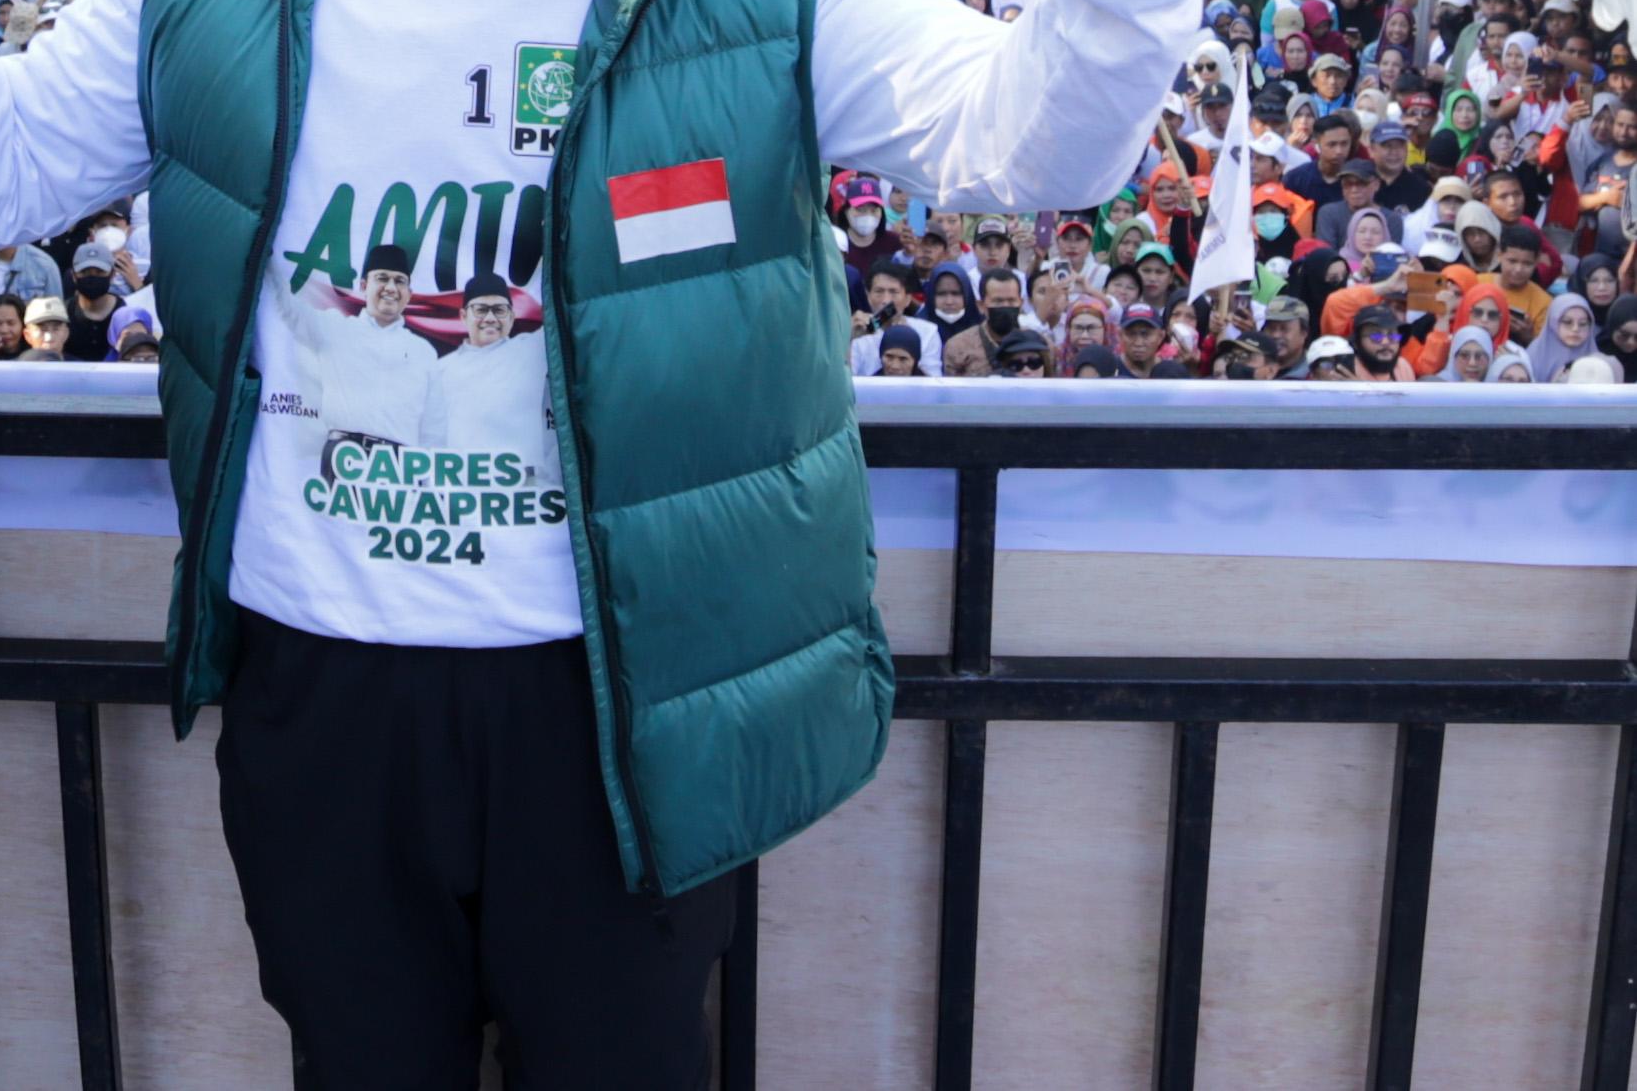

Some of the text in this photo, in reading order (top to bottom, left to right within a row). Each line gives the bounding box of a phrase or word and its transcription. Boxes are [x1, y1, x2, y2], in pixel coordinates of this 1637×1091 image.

[465, 66, 493, 126] 1
[270, 393, 303, 406] ANIES
[335, 445, 522, 487] CAPRES
[304, 477, 566, 526] CAWAPRES
[369, 526, 485, 565] 2024
